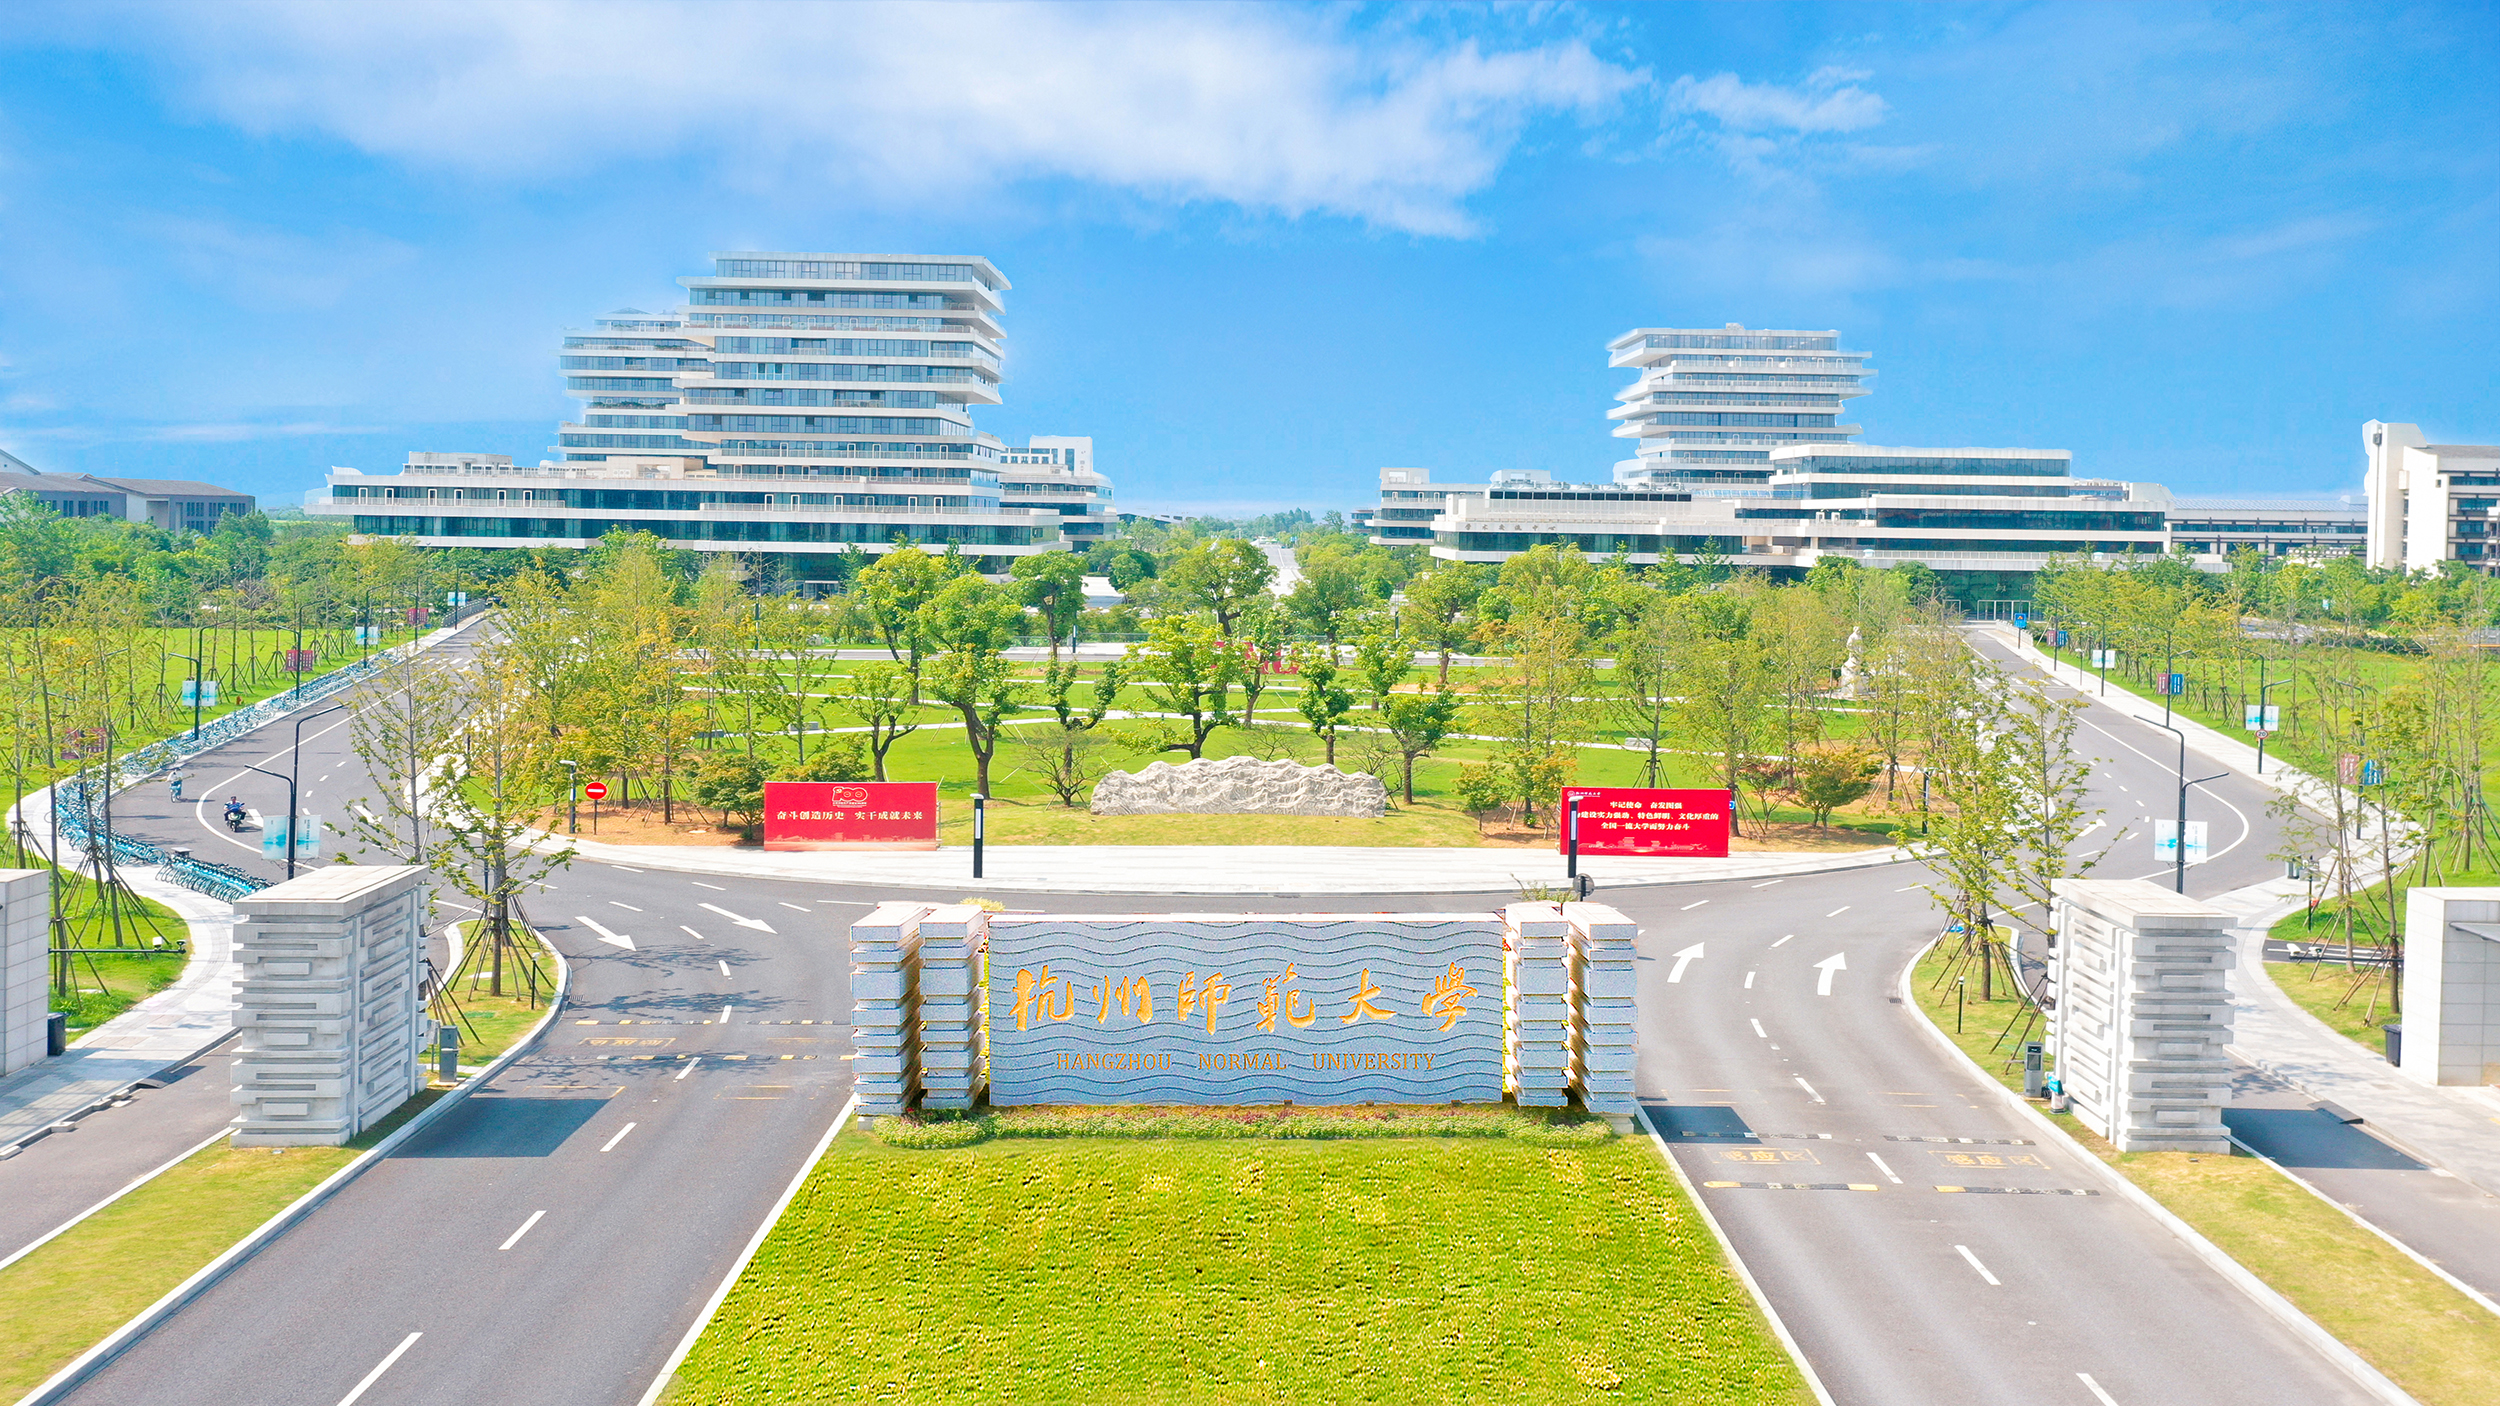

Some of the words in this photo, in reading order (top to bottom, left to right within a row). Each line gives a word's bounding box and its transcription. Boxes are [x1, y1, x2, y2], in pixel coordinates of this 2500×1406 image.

[1609, 801, 1642, 810] 牢记使命
[776, 810, 845, 820] 奋斗创造历史
[854, 810, 923, 820] 实干成就未来
[1056, 1053, 1172, 1071] HANGZHOU
[1198, 1053, 1288, 1070] NORMAL
[1312, 1053, 1436, 1070] UNIVERSITY
